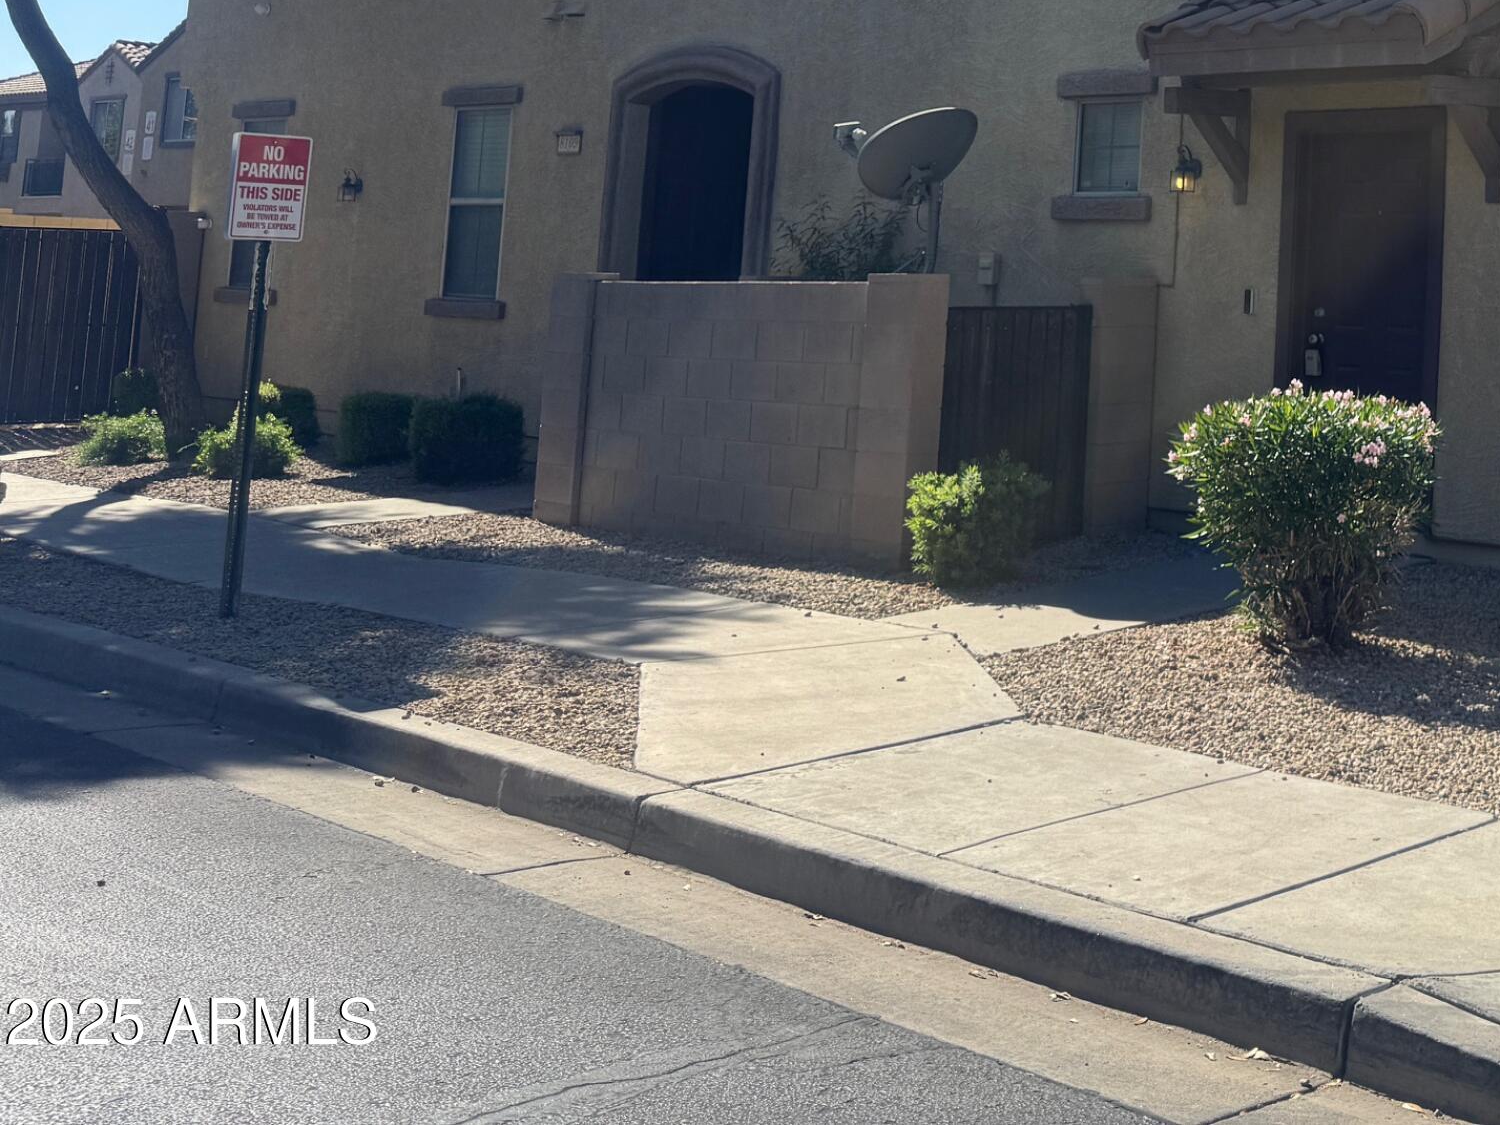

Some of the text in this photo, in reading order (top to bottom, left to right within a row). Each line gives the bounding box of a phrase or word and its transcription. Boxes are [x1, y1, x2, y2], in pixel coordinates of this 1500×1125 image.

[263, 145, 285, 161] NO
[239, 161, 305, 181] PARKING
[239, 185, 302, 202] THIS SIDE
[242, 203, 294, 213] VIOLATORS WILL
[256, 213, 278, 221] TOWED
[236, 221, 296, 231] OWNER'S EXPENSE
